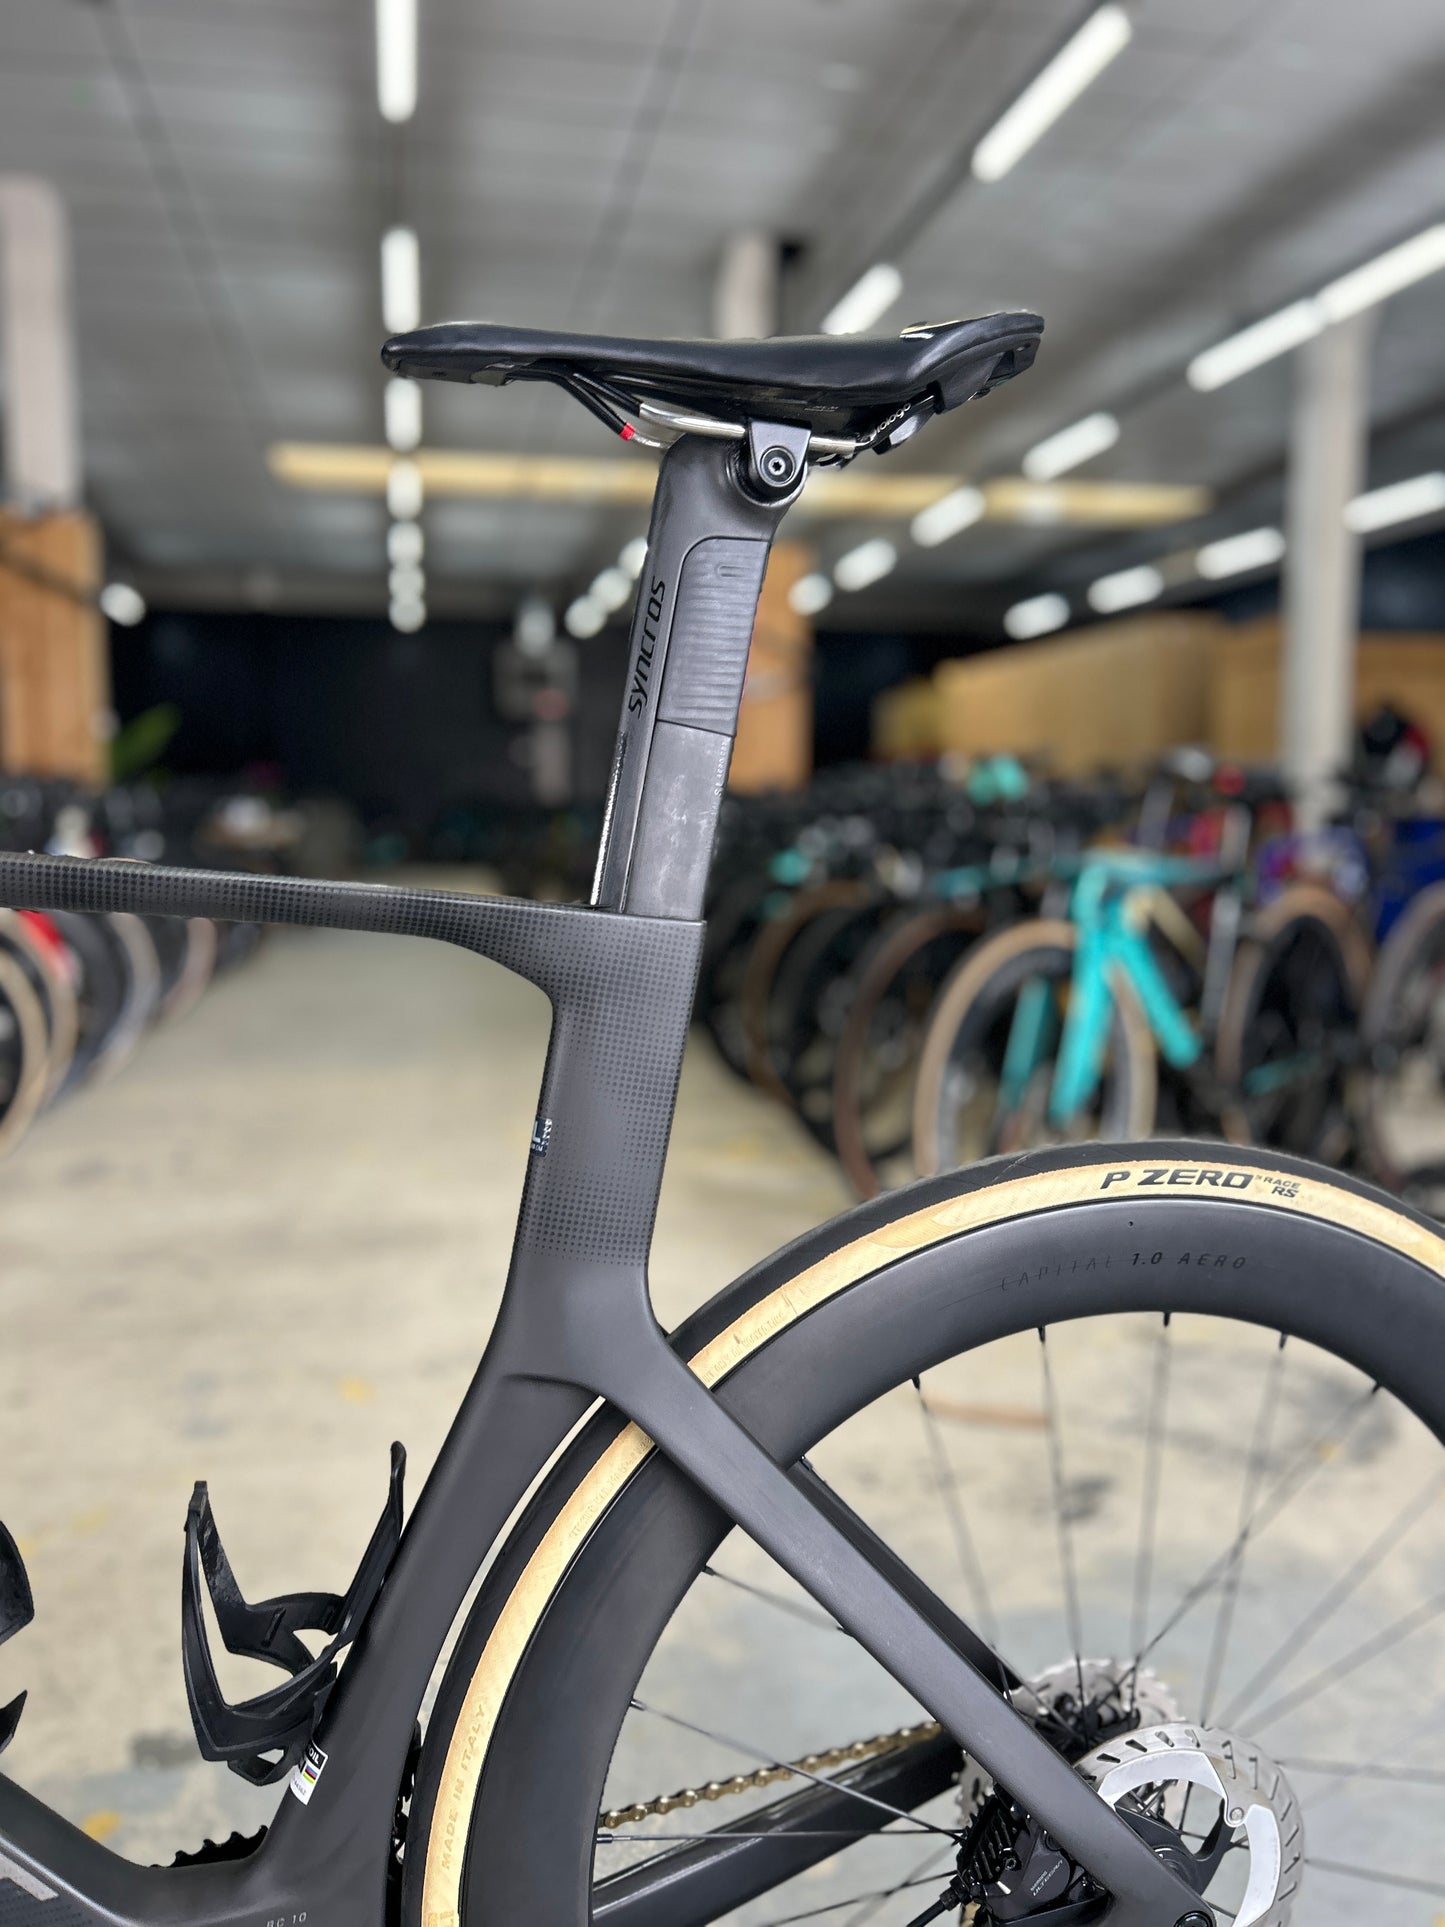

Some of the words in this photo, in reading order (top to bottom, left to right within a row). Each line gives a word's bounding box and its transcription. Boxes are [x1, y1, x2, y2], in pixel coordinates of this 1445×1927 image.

[628, 576, 666, 720] syncros
[1100, 1170, 1131, 1190] P
[1137, 1169, 1254, 1190] ZERO
[1263, 1176, 1301, 1190] RACE
[1271, 1186, 1299, 1198] RS
[1131, 1252, 1163, 1266] 1.0
[1177, 1252, 1246, 1269] AERO
[307, 1747, 319, 1765] OIL
[441, 1811, 459, 1870] MADE
[453, 1778, 465, 1801] IN
[460, 1704, 486, 1771] ITALY
[292, 1911, 307, 1924] 10
